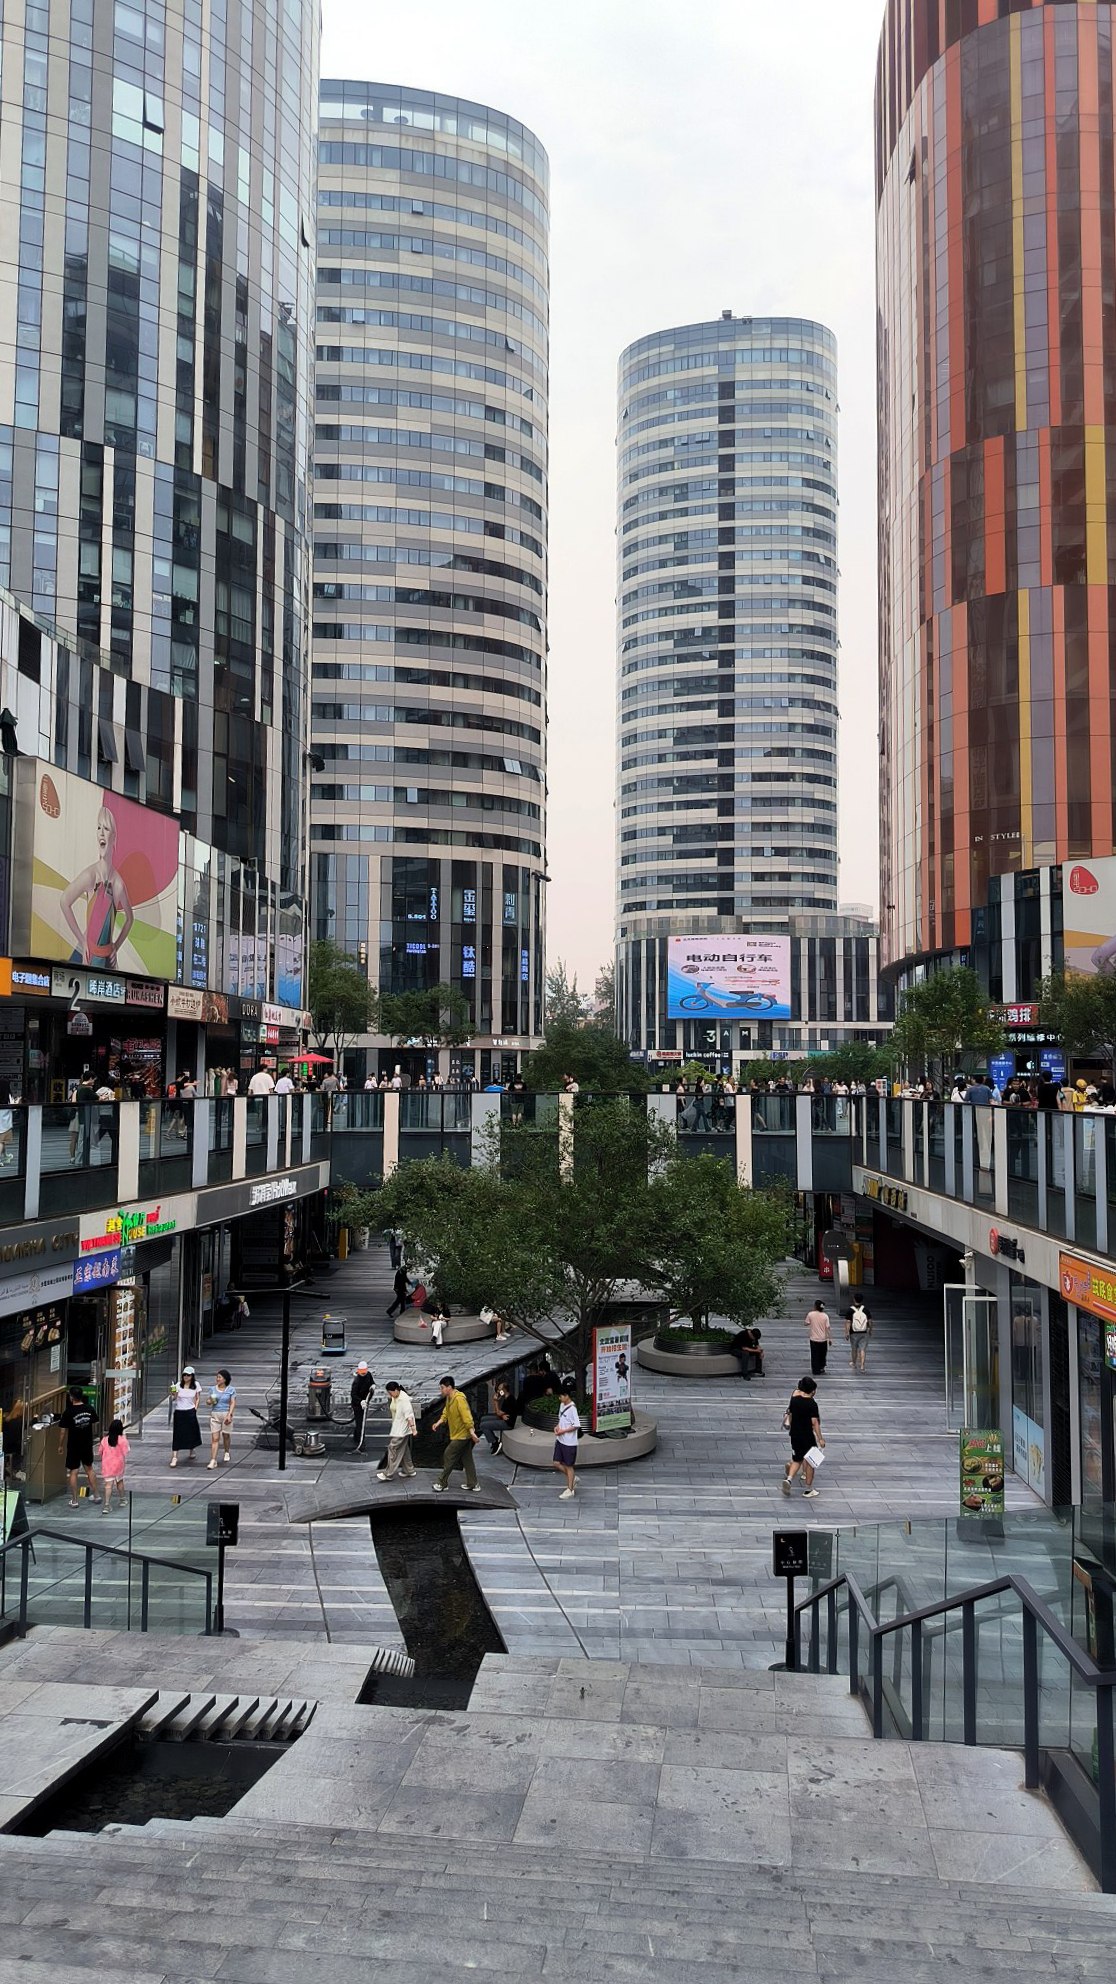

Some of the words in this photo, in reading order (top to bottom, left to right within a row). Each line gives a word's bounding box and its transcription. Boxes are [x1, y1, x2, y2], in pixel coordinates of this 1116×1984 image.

[430, 887, 438, 920] TATTOO
[686, 953, 773, 963] 电动自行车
[68, 977, 81, 1011] 2
[242, 1003, 258, 1017] DORA
[987, 1006, 1032, 1023] 鸡排
[703, 1051, 721, 1059] coffee
